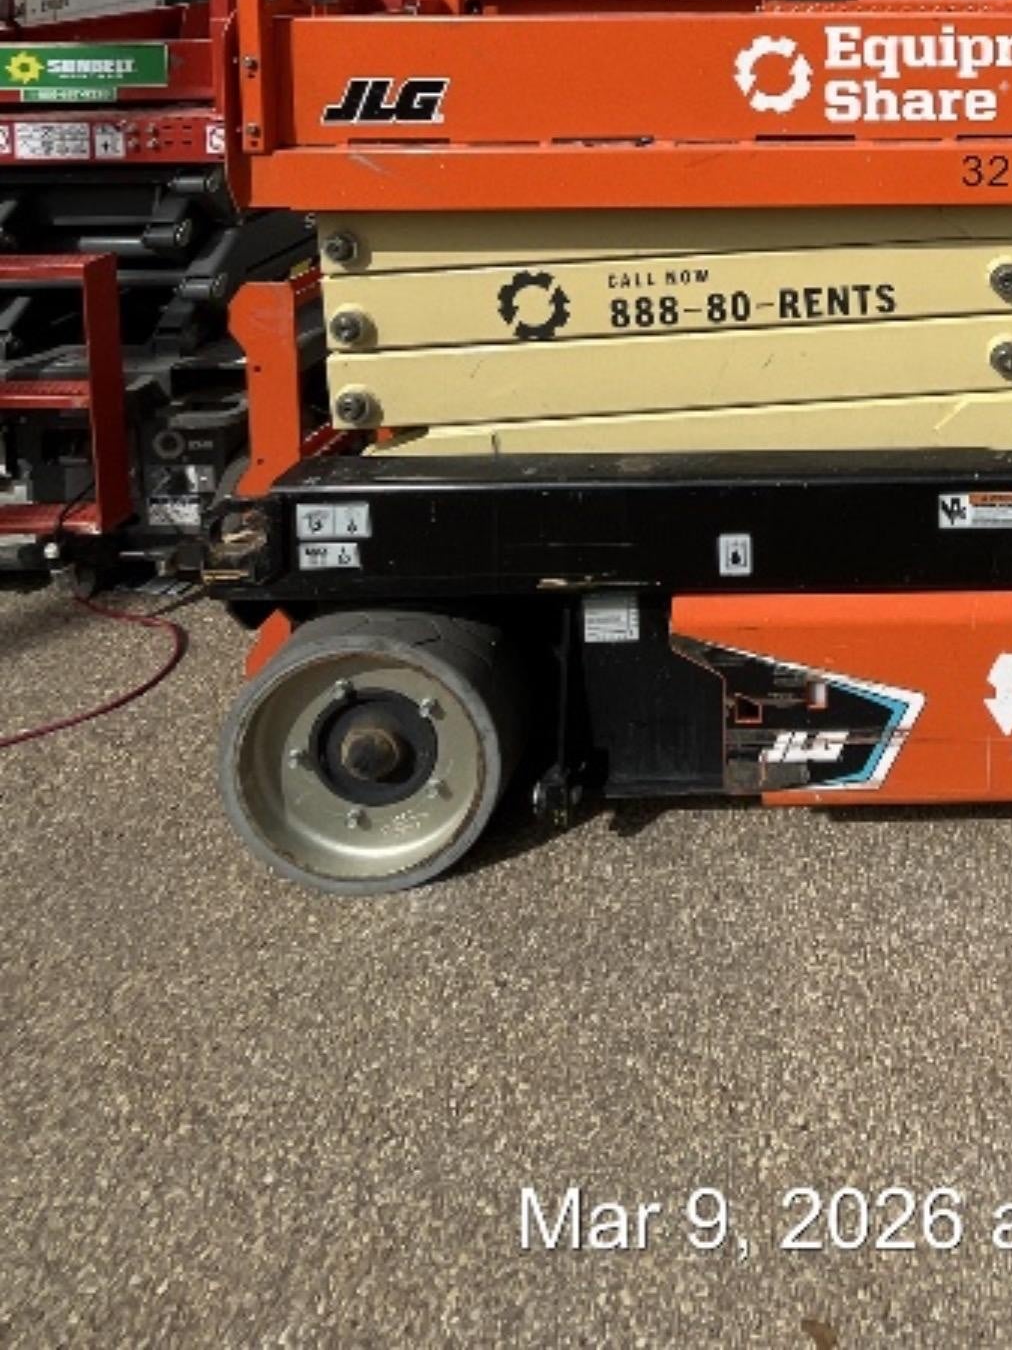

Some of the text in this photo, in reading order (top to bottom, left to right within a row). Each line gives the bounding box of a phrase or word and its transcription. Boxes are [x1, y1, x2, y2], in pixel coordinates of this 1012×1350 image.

[321, 77, 450, 125] JLG
[824, 80, 998, 122] Share
[608, 269, 709, 289] CALL NOW
[610, 284, 897, 328] 888-80-RENTS
[758, 731, 849, 763] JLG
